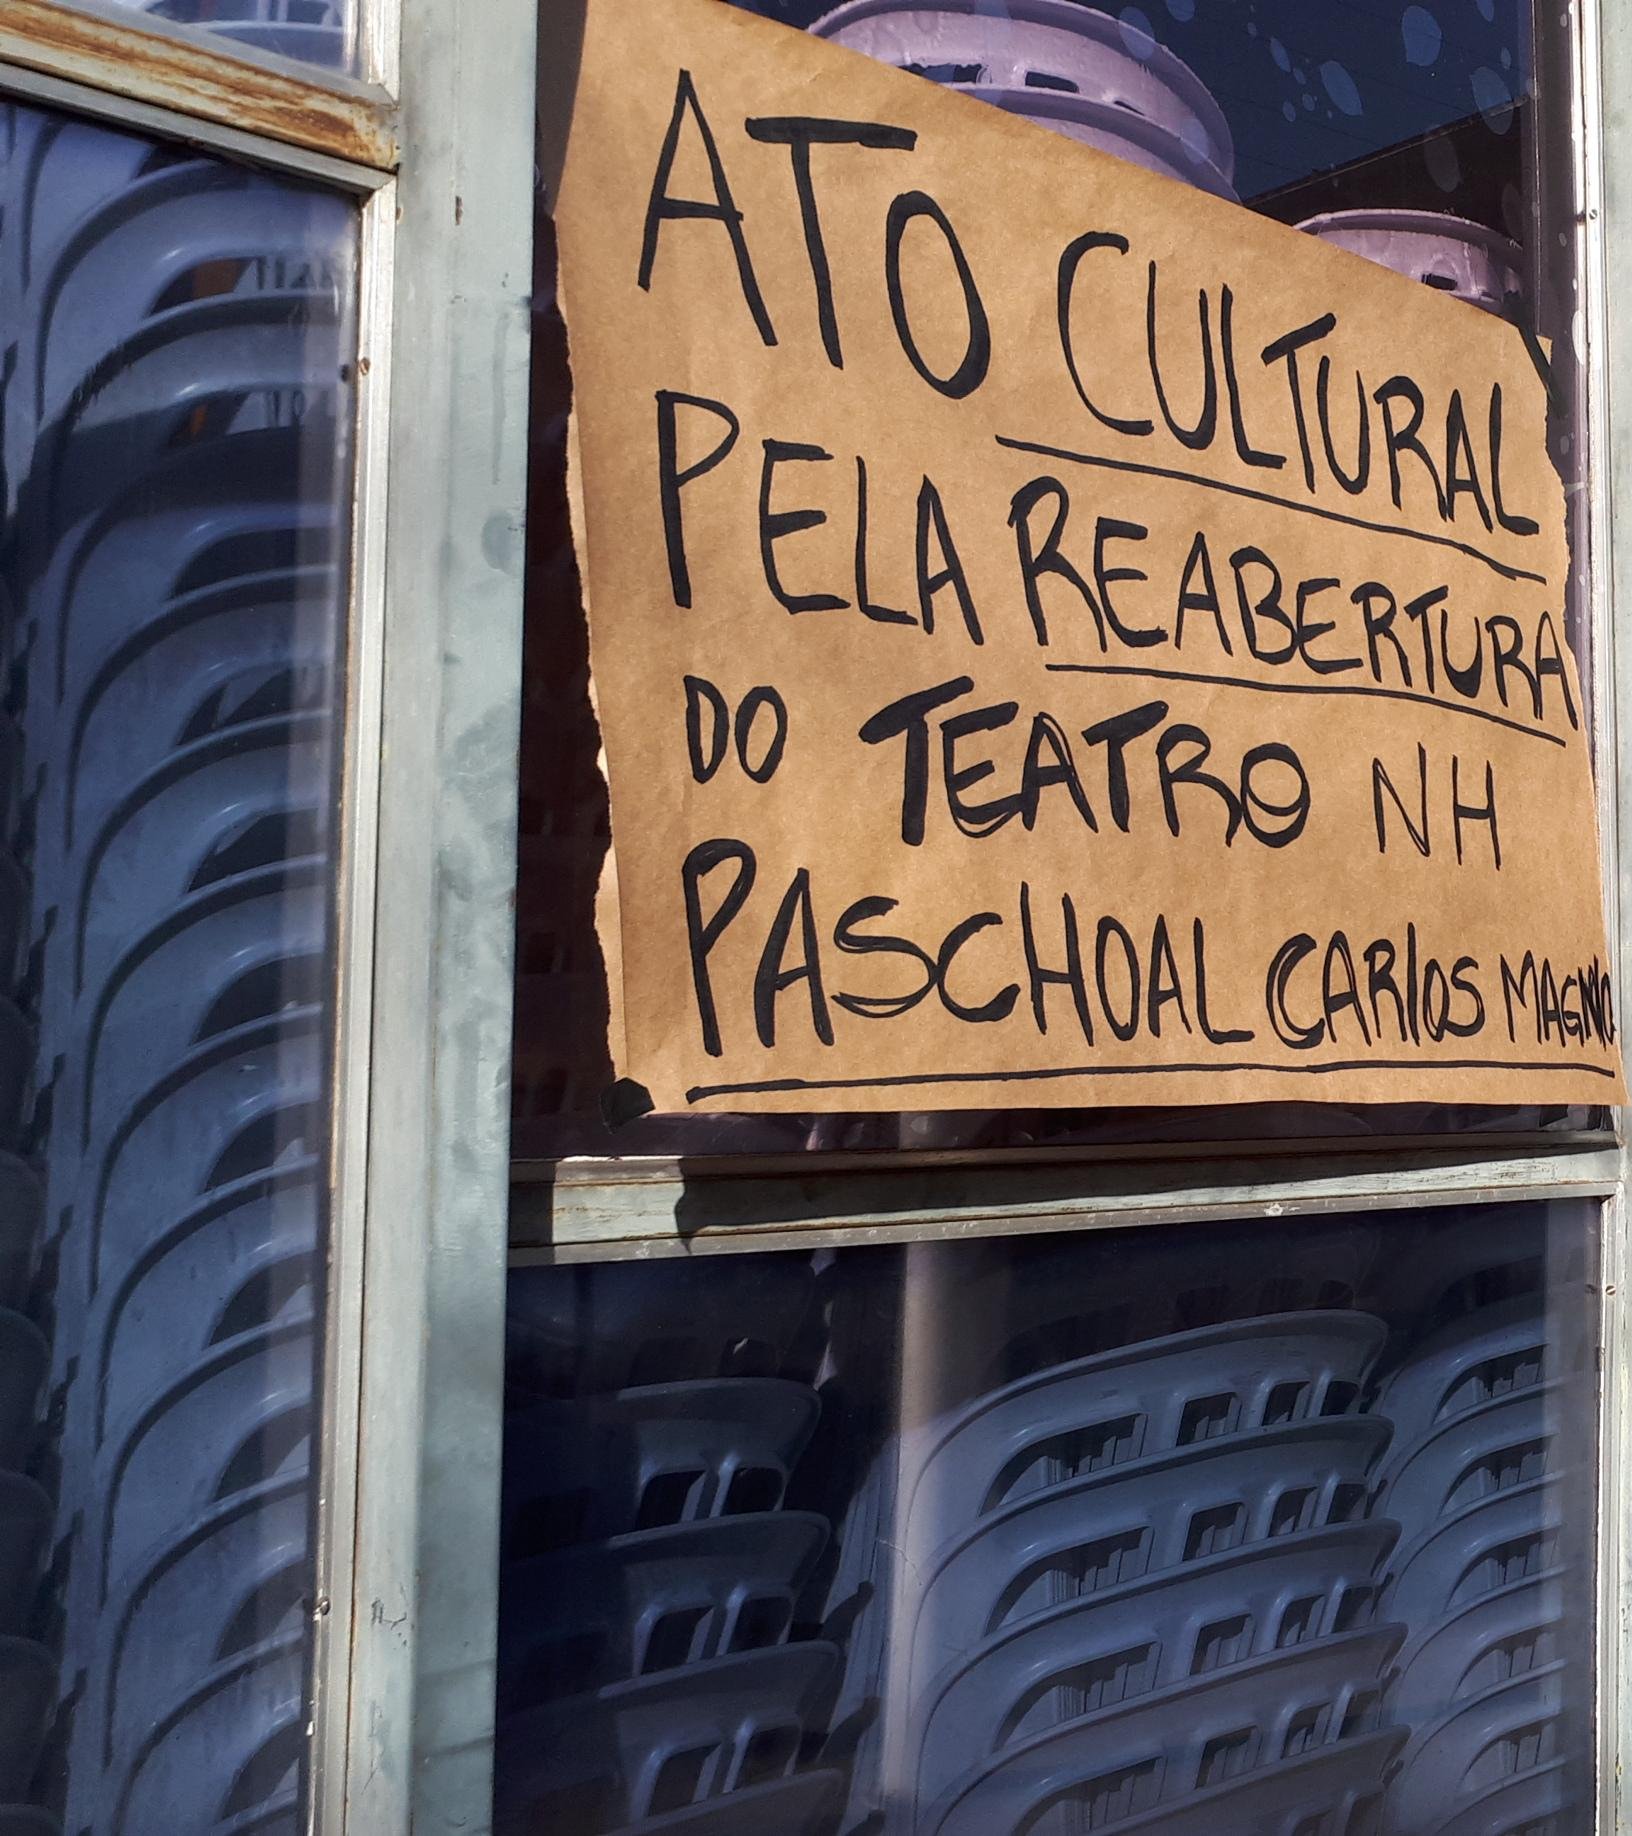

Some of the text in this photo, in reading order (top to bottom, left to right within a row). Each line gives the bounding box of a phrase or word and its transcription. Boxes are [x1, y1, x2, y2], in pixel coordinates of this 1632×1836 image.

[639, 69, 1541, 535] ATO CULTURAL
[655, 389, 1578, 729] PELA REABERTURA
[684, 674, 1502, 871] DO TEATRO NH
[681, 837, 1256, 1058] PASCHOAL
[1500, 949, 1617, 1052] MAGNO
